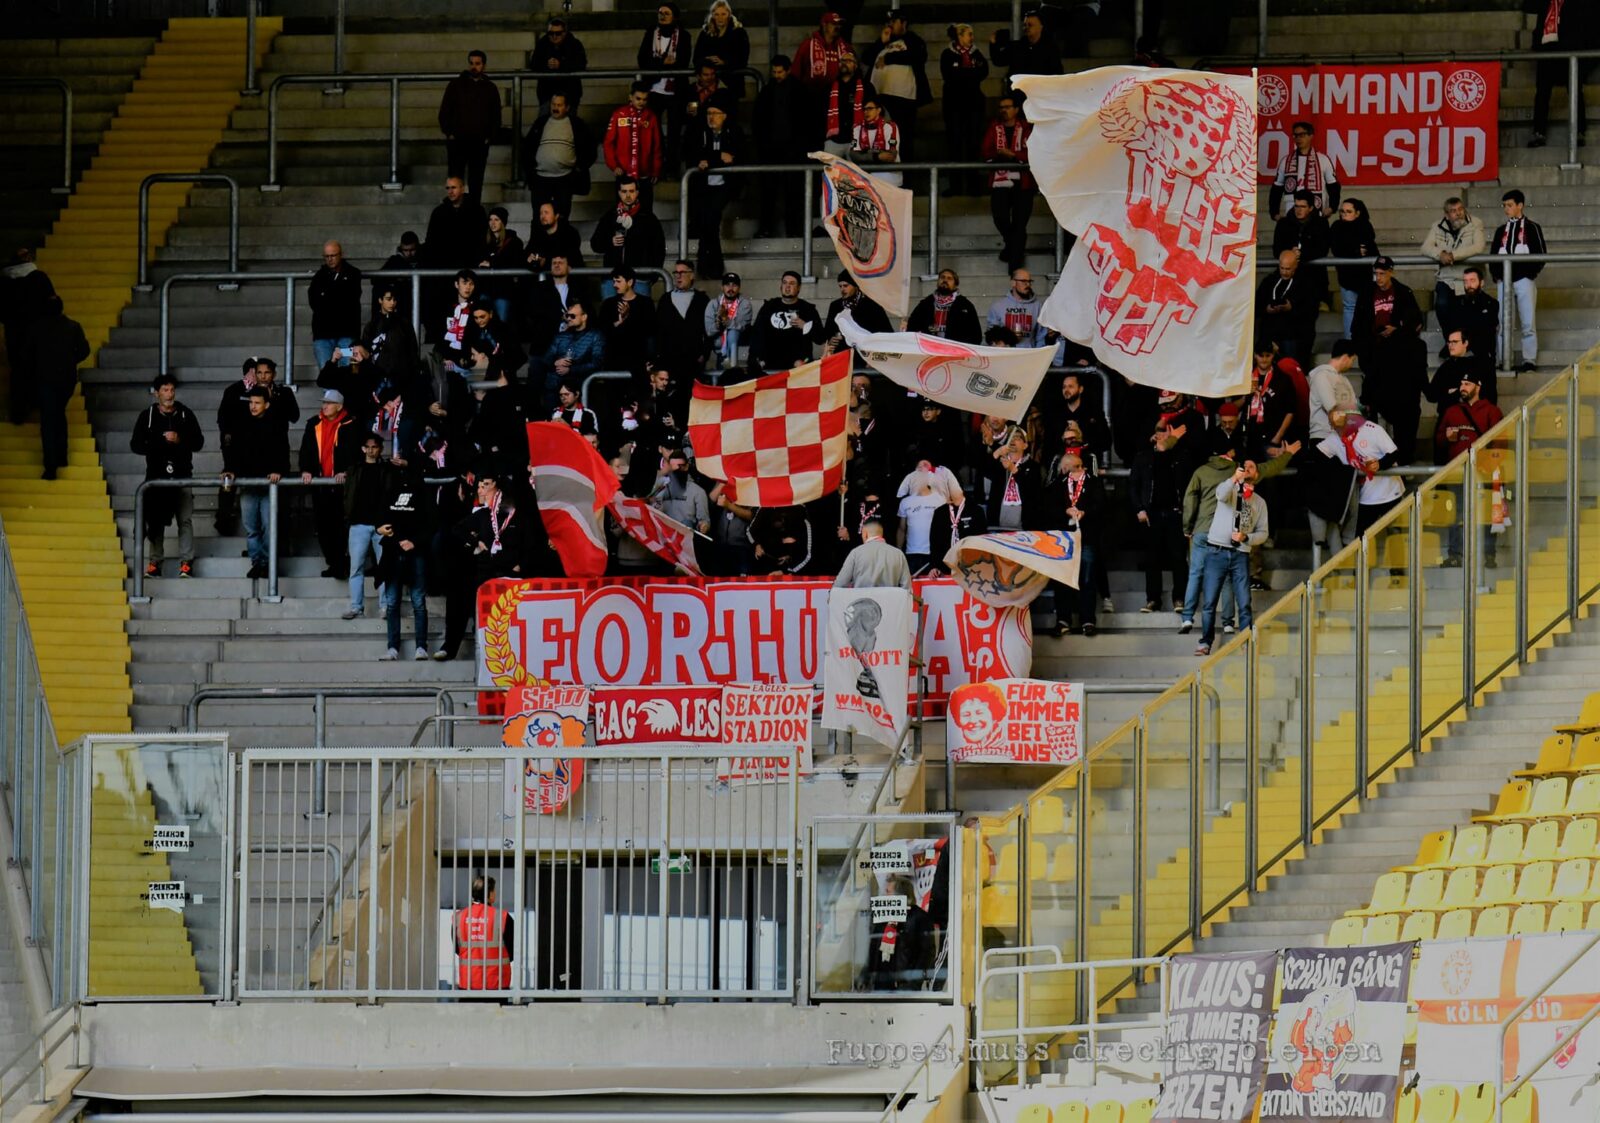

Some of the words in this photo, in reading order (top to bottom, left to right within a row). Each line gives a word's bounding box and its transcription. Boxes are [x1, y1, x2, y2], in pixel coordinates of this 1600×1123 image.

[1260, 77, 1287, 103] ORTUNA
[1258, 115, 1486, 177] ÖN-SÜD
[516, 586, 970, 690] FORTUA
[752, 684, 787, 692] EAGLES
[1006, 682, 1047, 700] FÜR
[725, 692, 811, 717] SEKTION
[1008, 701, 1079, 722] IMMER
[723, 718, 809, 744] STADION
[1007, 723, 1042, 741] BEI
[1010, 743, 1052, 762] UNS
[755, 771, 775, 780] 186
[1169, 960, 1265, 1011] KLAUS:
[1446, 1000, 1498, 1022] KÖLN
[1190, 1011, 1260, 1042] IMMER
[1261, 1089, 1304, 1117] EKTION
[1309, 1090, 1387, 1119] BIERSTAND
